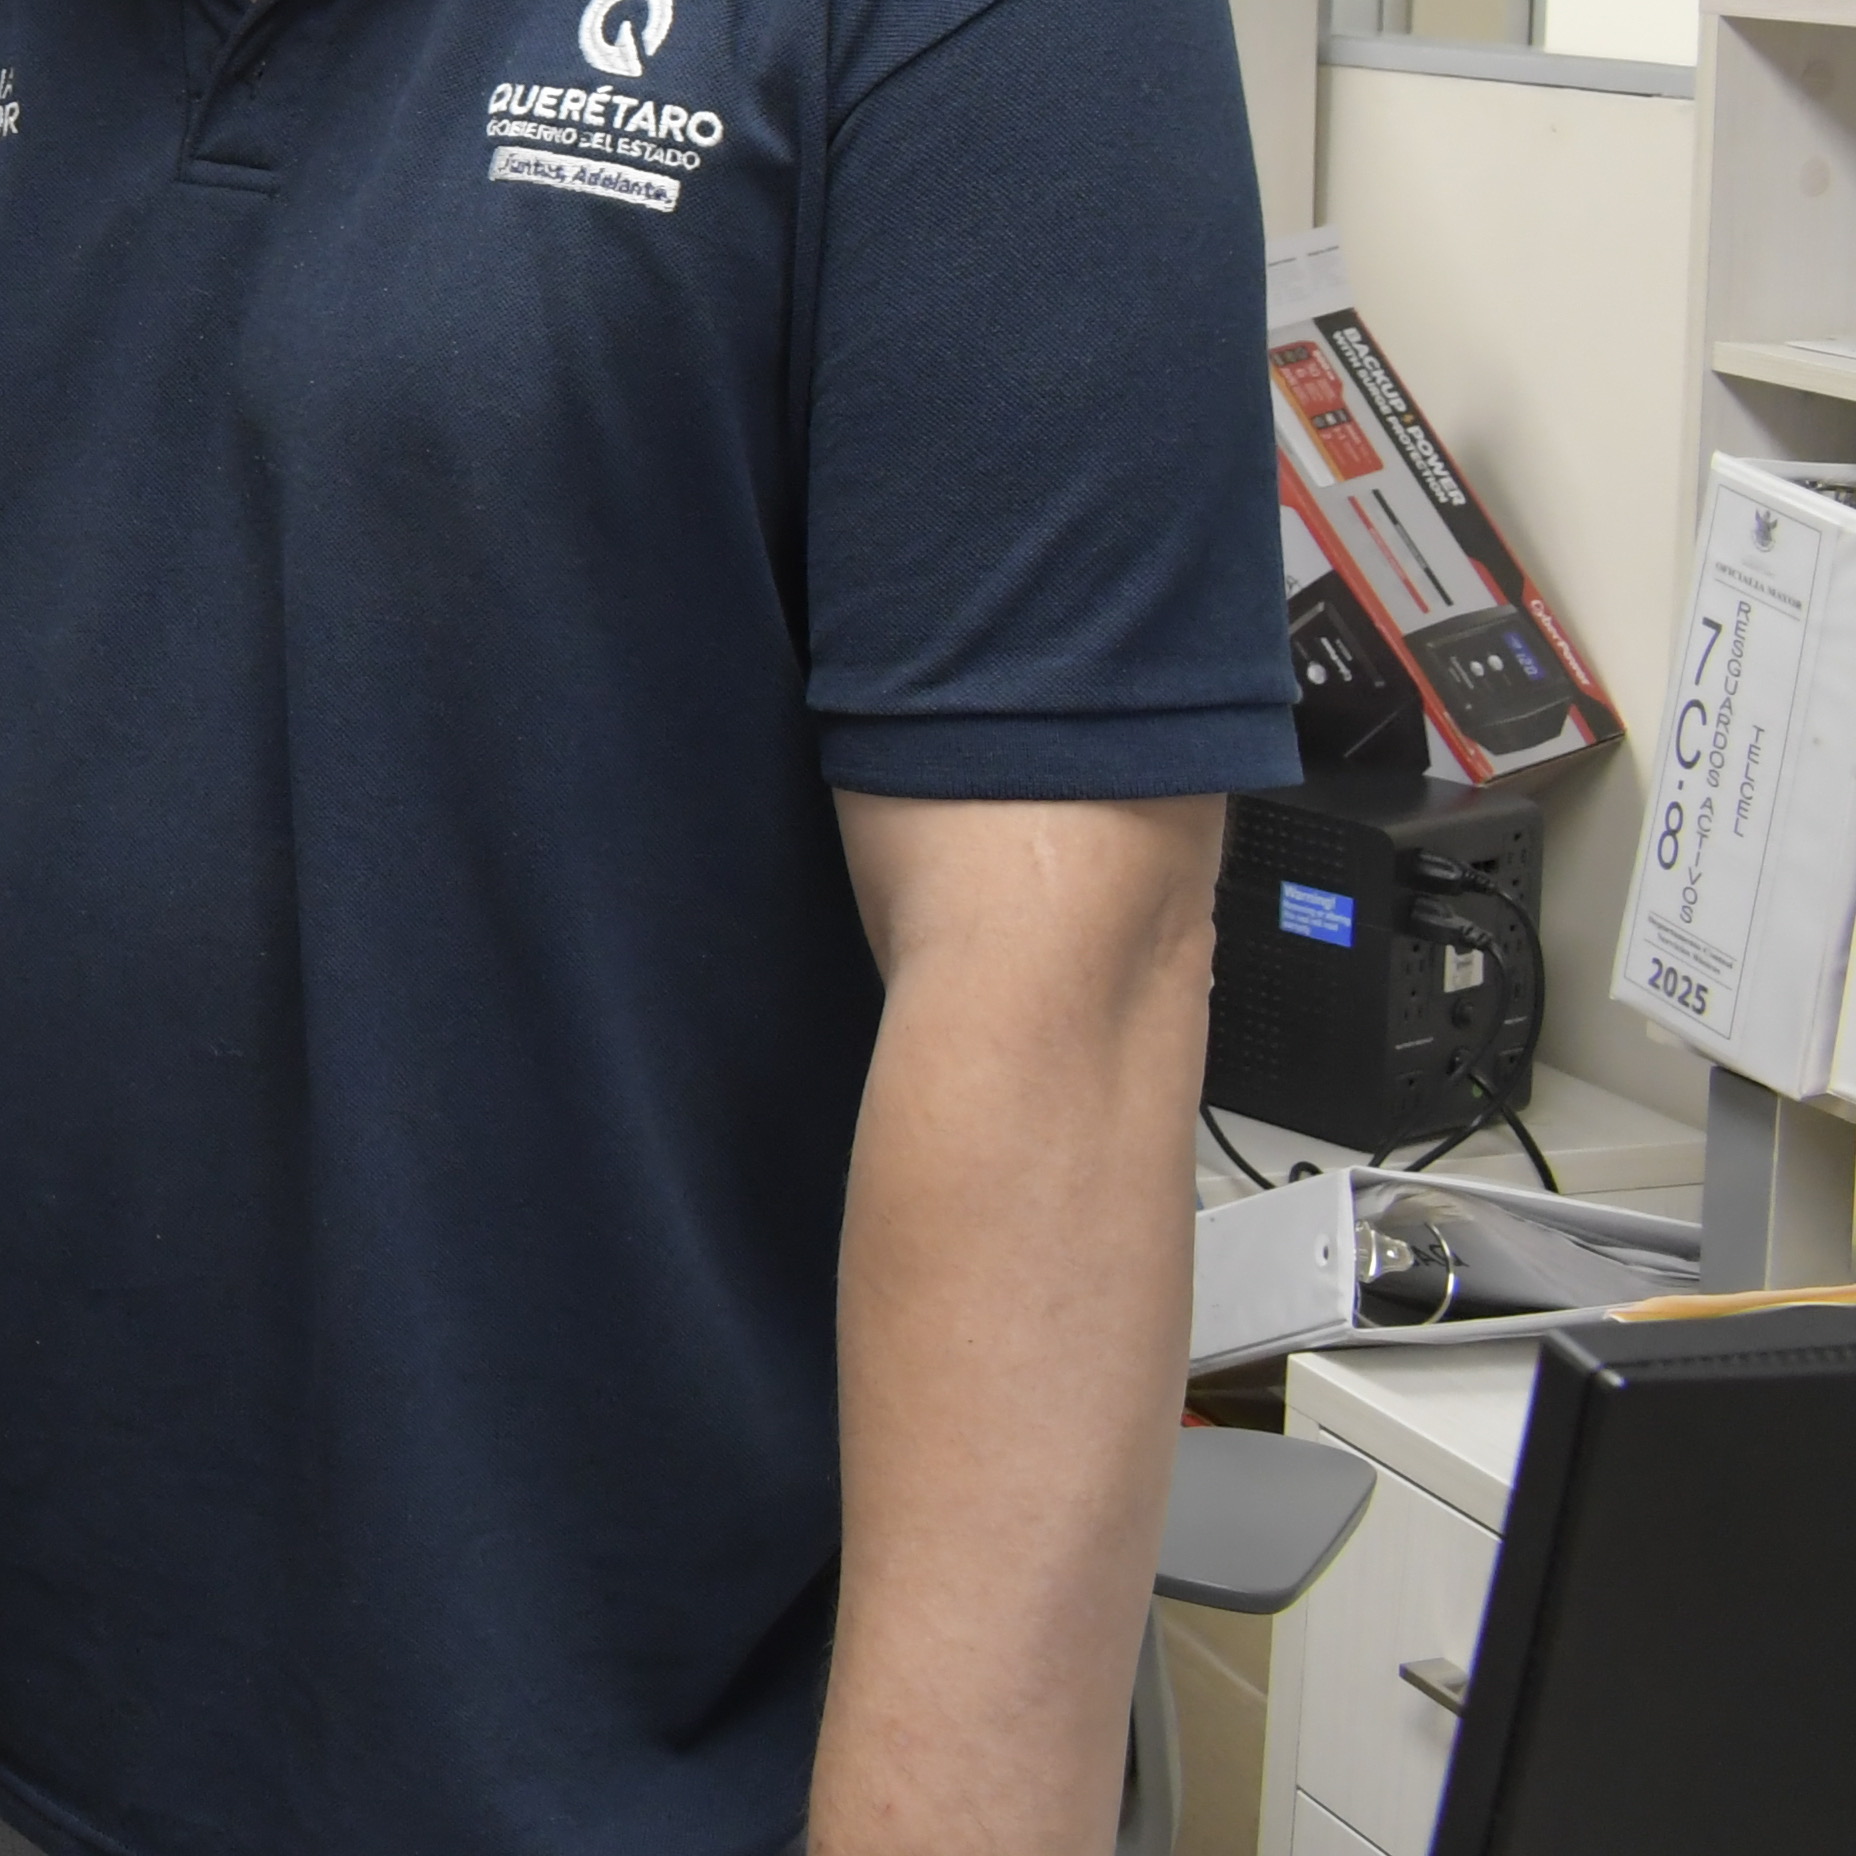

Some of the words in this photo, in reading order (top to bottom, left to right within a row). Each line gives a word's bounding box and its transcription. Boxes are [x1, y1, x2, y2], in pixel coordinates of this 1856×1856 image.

[486, 118, 578, 145] GOBIERNO
[616, 136, 702, 171] ESTADO
[488, 82, 725, 148] QUERÉTARO
[1332, 330, 1361, 369] WITH
[1356, 369, 1392, 415] SURGE
[1386, 415, 1450, 504] PROTECTION
[1342, 326, 1407, 413] BACKUP
[1406, 425, 1467, 506] POWER
[1530, 599, 1591, 685] CyberPower
[1705, 601, 1751, 788] RESGUARDOS
[1733, 725, 1765, 838] TELCEL
[1679, 796, 1715, 924] ACTIVOS
[1648, 957, 1709, 1015] 2025
